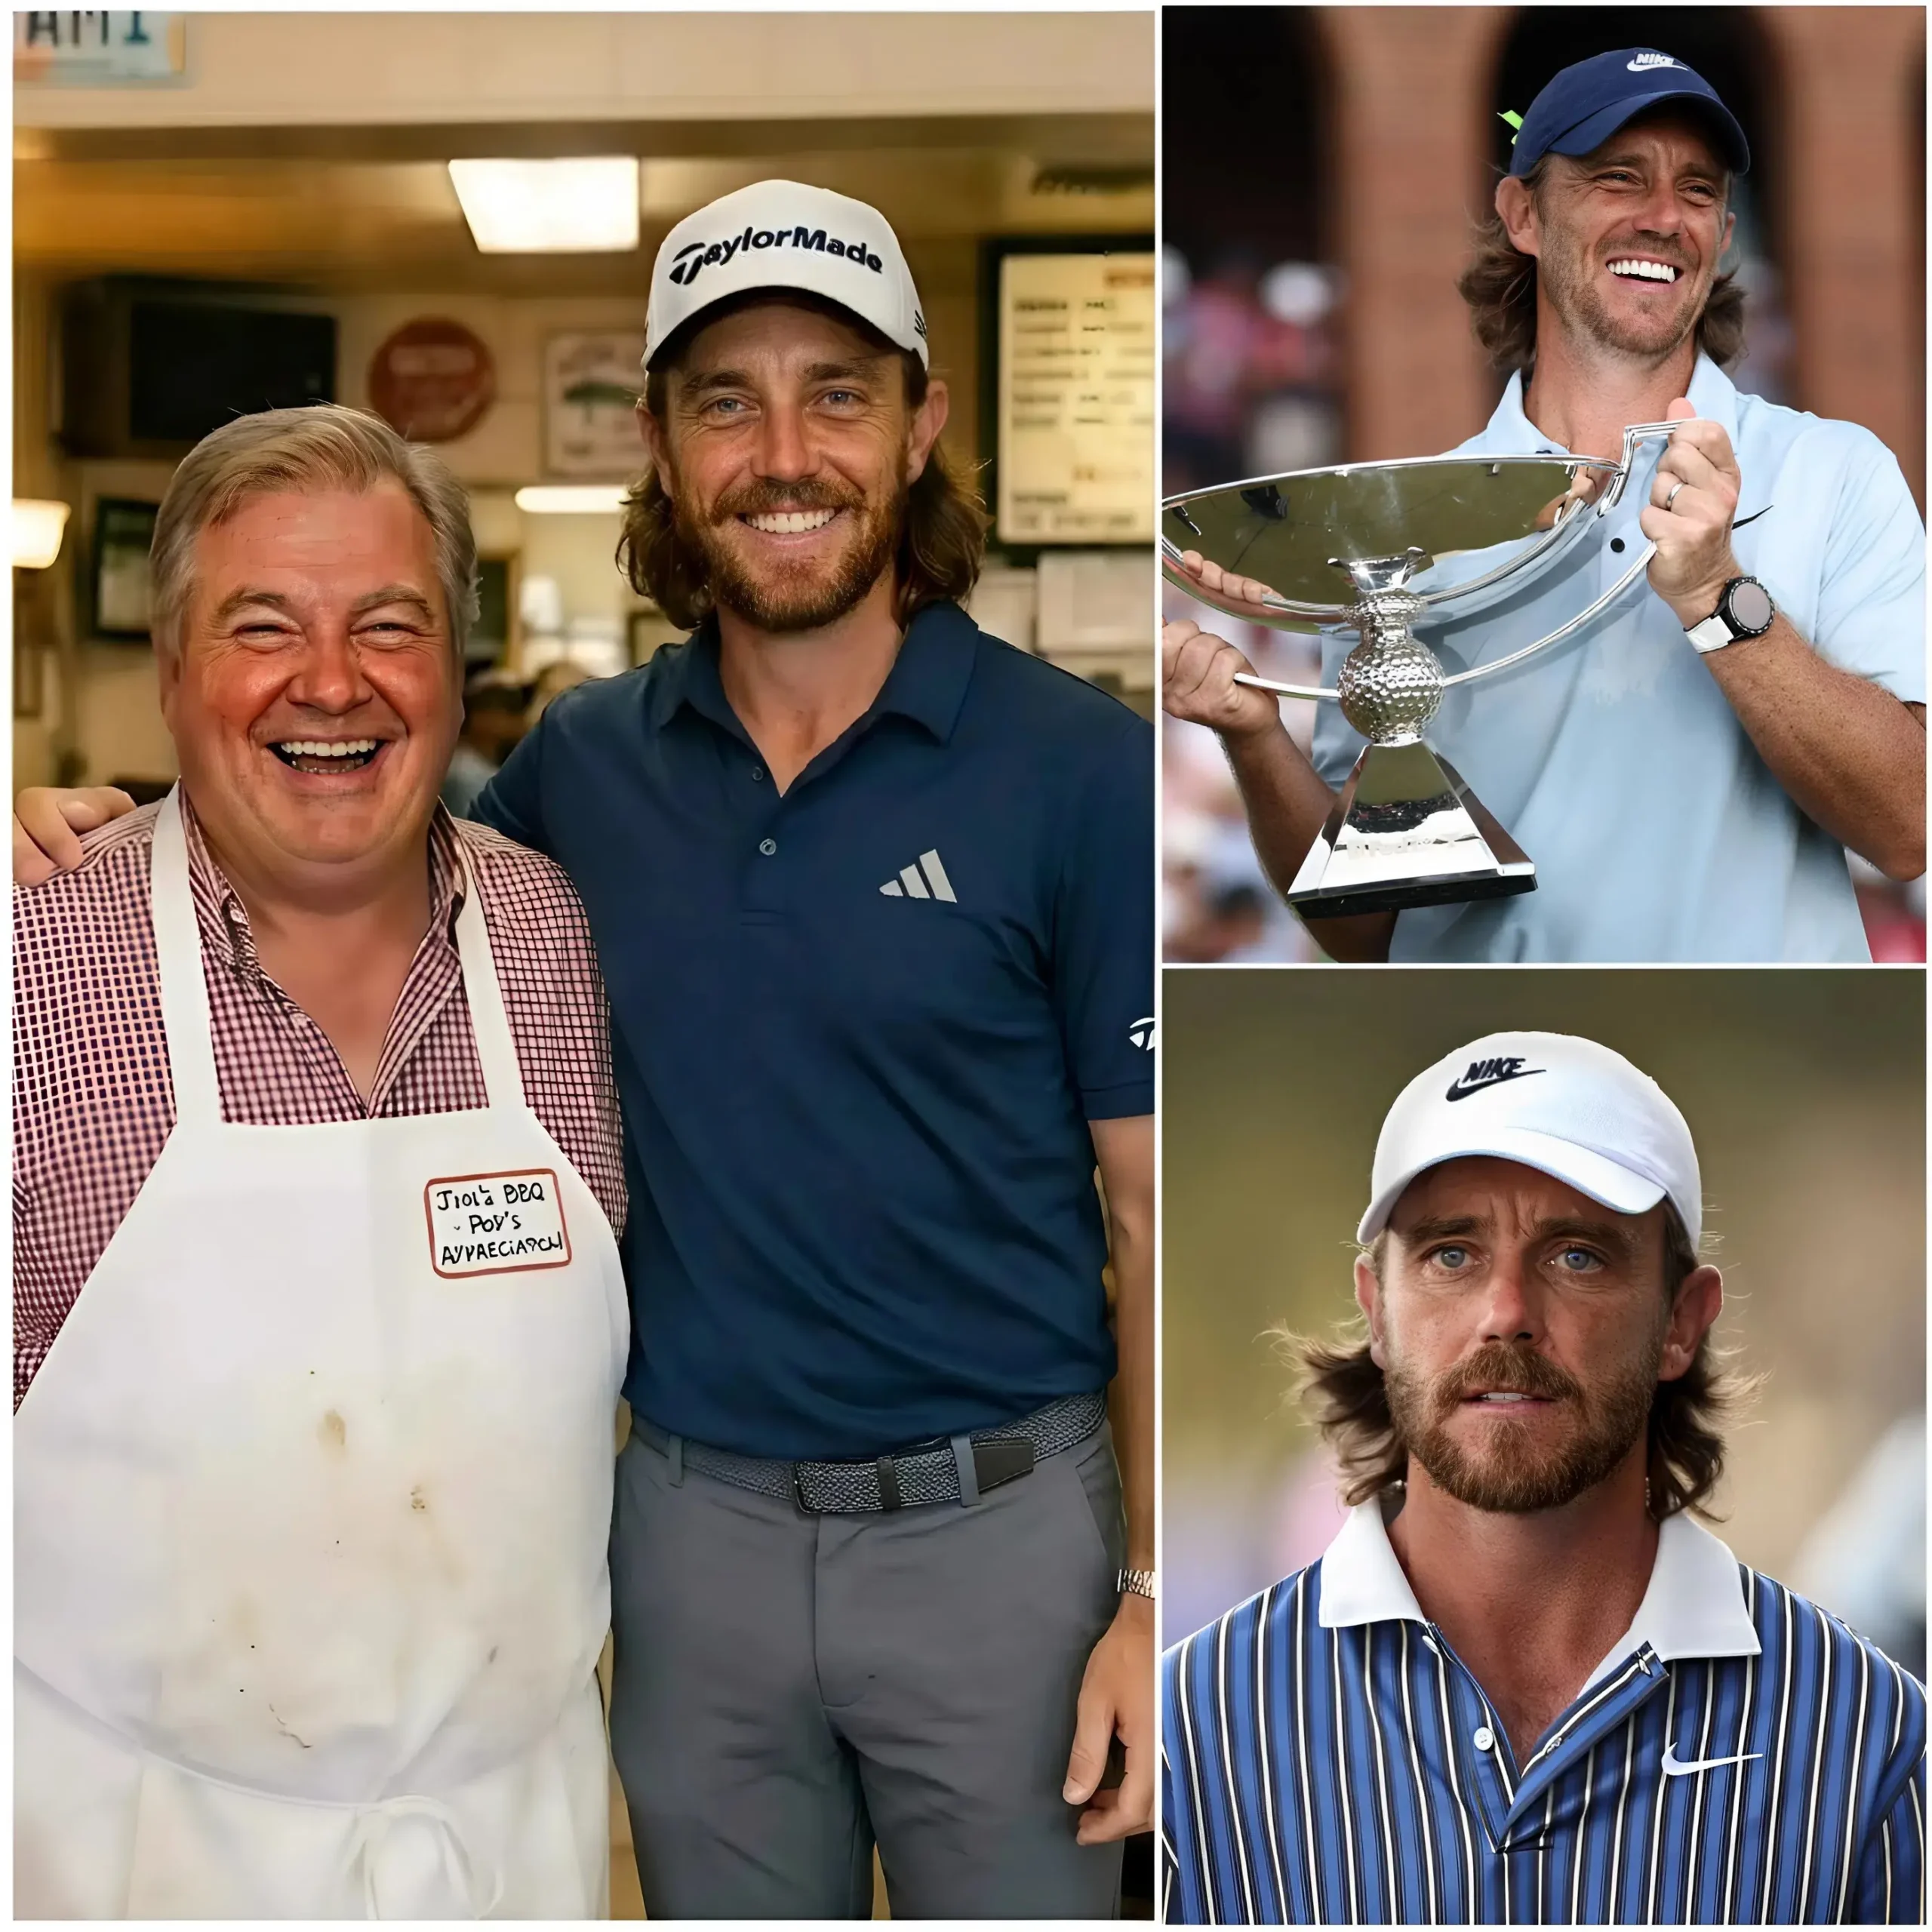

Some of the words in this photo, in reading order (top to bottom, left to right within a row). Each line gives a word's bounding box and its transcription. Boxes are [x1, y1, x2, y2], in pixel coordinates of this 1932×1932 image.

[1635, 53, 1675, 66] NIKE
[669, 226, 883, 285] TaylorMade
[1462, 1057, 1527, 1084] NIKE
